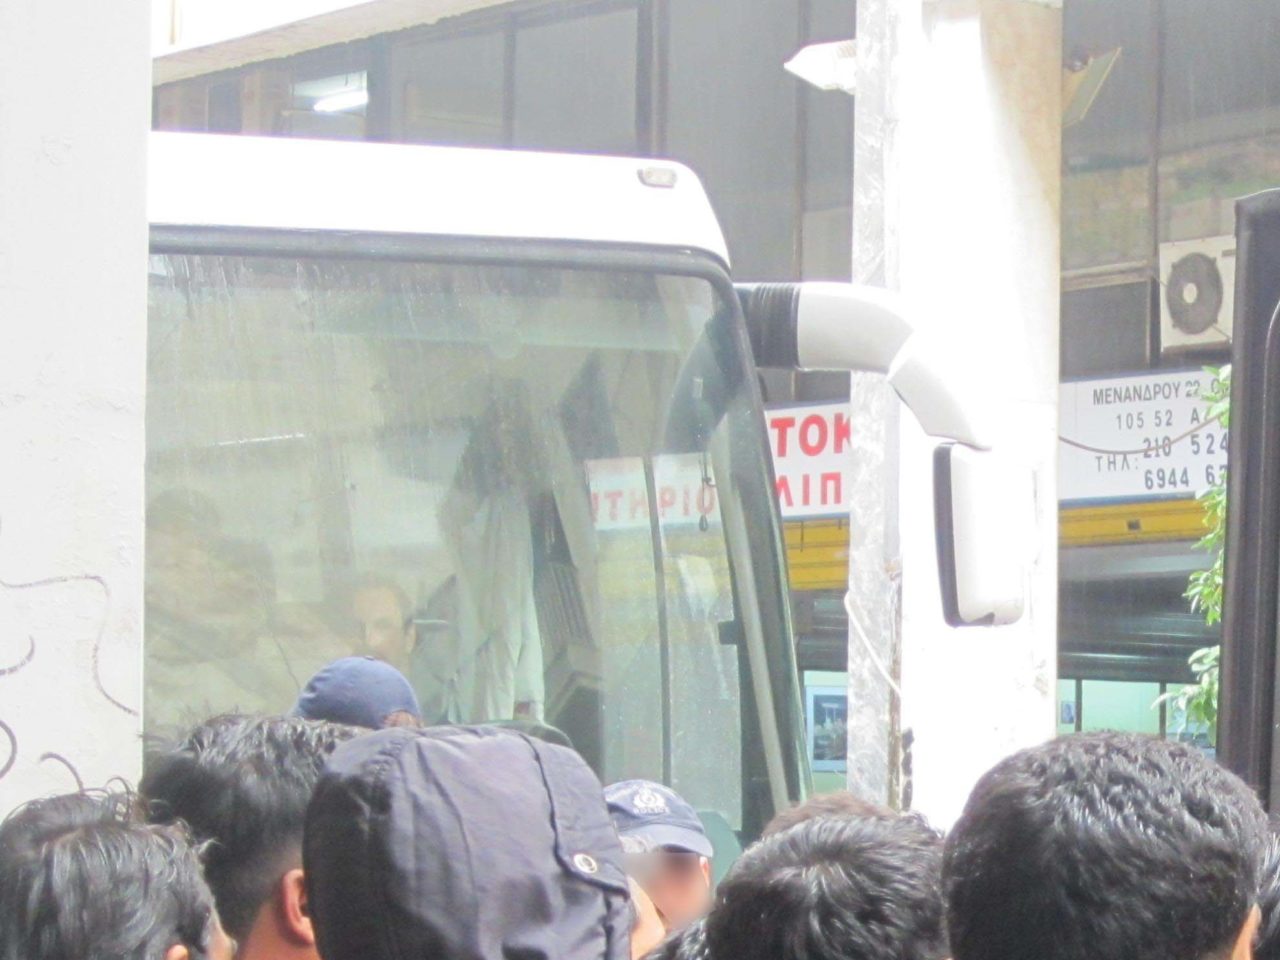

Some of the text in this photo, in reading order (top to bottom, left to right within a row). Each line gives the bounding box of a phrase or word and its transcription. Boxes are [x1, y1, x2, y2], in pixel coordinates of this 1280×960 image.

[1093, 382, 1181, 405] ΜΕΝΑΝΔΡΟΥ
[1185, 380, 1200, 398] 22
[1117, 412, 1144, 430] 105
[1154, 409, 1173, 427] 52
[770, 412, 850, 457] ΤΟΚ
[1143, 432, 1228, 459] 210 524
[1095, 454, 1138, 472] ΤΗΛ:
[1145, 467, 1189, 490] 6944
